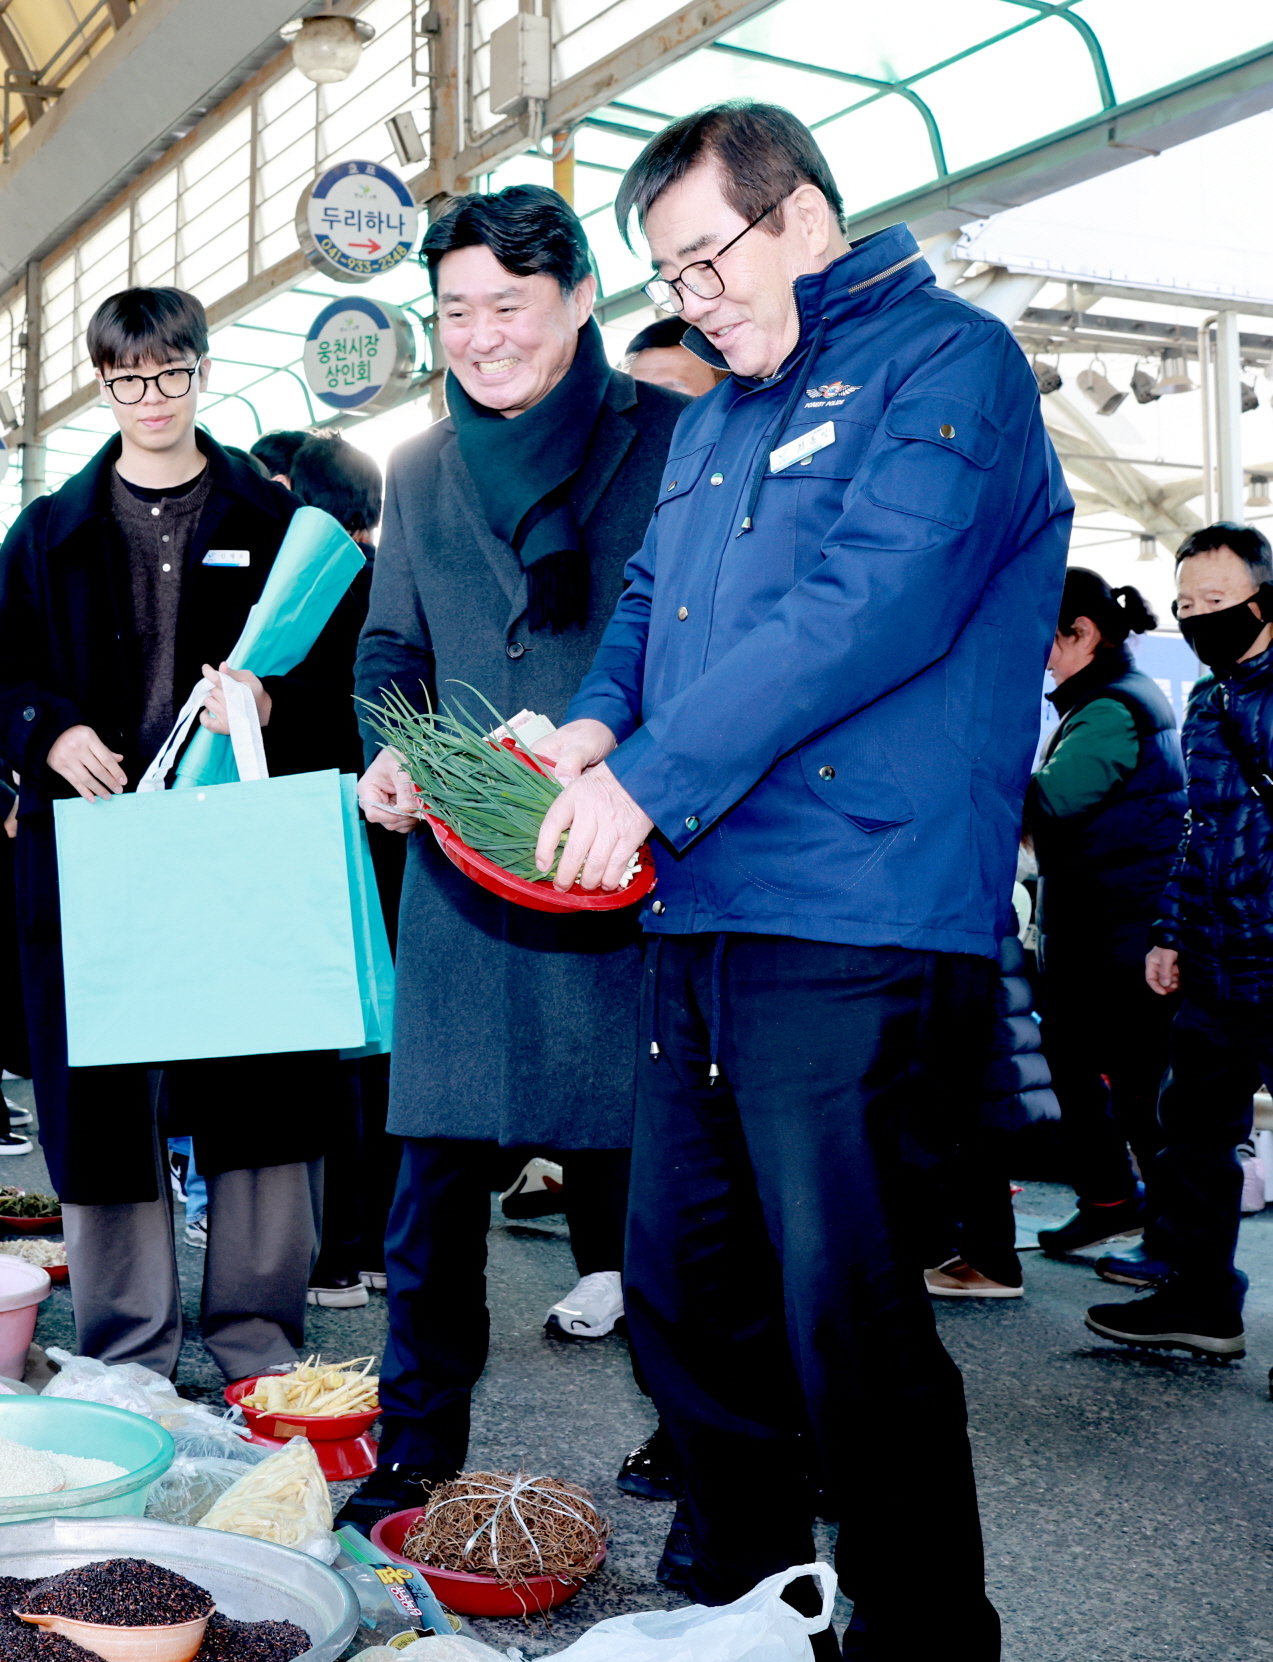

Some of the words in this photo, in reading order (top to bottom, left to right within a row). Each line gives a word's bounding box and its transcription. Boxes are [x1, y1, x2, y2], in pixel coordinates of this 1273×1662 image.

[321, 207, 406, 236] 두리하나
[320, 239, 408, 273] 041-933-2348
[317, 333, 380, 364] 웅천시장
[326, 359, 372, 388] 상인회
